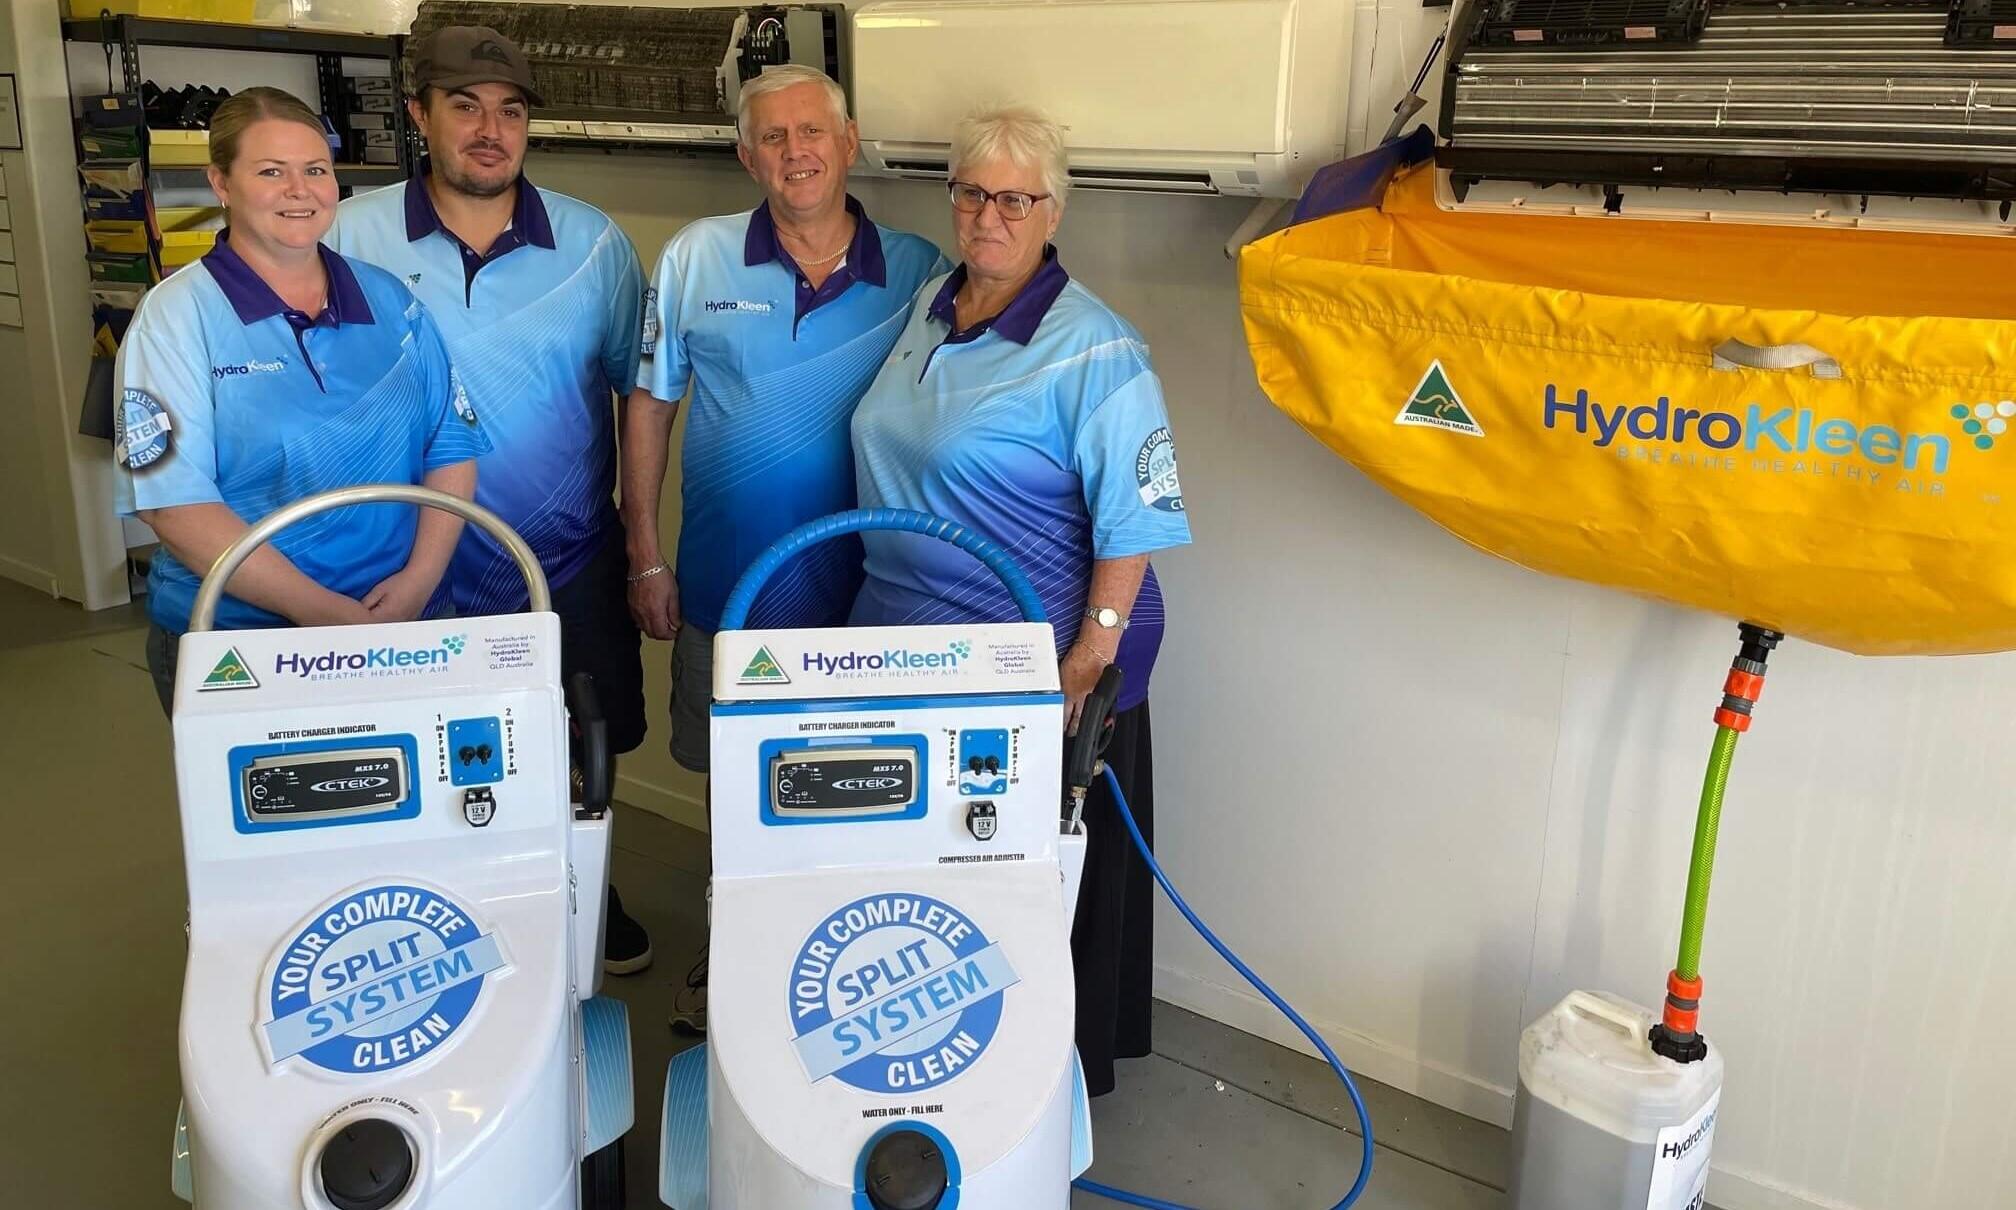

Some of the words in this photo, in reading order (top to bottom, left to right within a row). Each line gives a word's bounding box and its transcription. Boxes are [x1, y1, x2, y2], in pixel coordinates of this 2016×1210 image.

[705, 300, 770, 312] HydroKleen
[1404, 414, 1451, 428] AUSTRALIAN
[1452, 423, 1475, 433] MADE
[1544, 383, 1951, 474] HydroKleen
[1137, 447, 1151, 481] YOUR
[1151, 456, 1174, 477] SPL
[1616, 444, 1736, 472] BREATHE
[1751, 460, 1881, 486] HEALTHY
[1896, 477, 1945, 496] AIR
[1151, 472, 1177, 497] SYS
[275, 647, 448, 678] HydroKleen
[311, 671, 364, 681] BREATHE
[370, 668, 425, 678] HEALTHY
[430, 665, 448, 674] AIR
[803, 649, 957, 676] HydroKleen
[835, 670, 883, 680] BREATHE
[889, 669, 936, 678] HEALTHY
[941, 668, 958, 676] AIR
[268, 729, 300, 740] BATTERY
[301, 726, 336, 738] CHARGER
[337, 724, 376, 735] INDICATOR
[799, 723, 827, 731] BATTERY
[828, 722, 859, 730] CHARGER
[860, 720, 896, 729] INDICATOR
[374, 763, 389, 771] 7.0
[325, 778, 370, 791] CTEK
[844, 779, 886, 789] CTEK
[938, 855, 981, 864] COMPRESSED
[982, 854, 993, 862] AIR
[994, 853, 1025, 862] ADJUSTER
[278, 932, 331, 1001] YOUR
[324, 891, 467, 938] COMPLETE
[796, 940, 838, 1018] YOUR
[827, 898, 973, 948] COMPLETE
[321, 931, 421, 992] SPLIT
[836, 938, 932, 1006] SPLIT
[306, 949, 474, 1038] SYSTEM
[832, 960, 989, 1056] SYSTEM
[352, 1012, 451, 1068] CLEAN
[887, 1030, 981, 1088] CLEAN
[862, 1108, 888, 1118] WATER
[888, 1107, 906, 1116] ONLY
[911, 1105, 924, 1115] FILL
[925, 1104, 943, 1113] HERE
